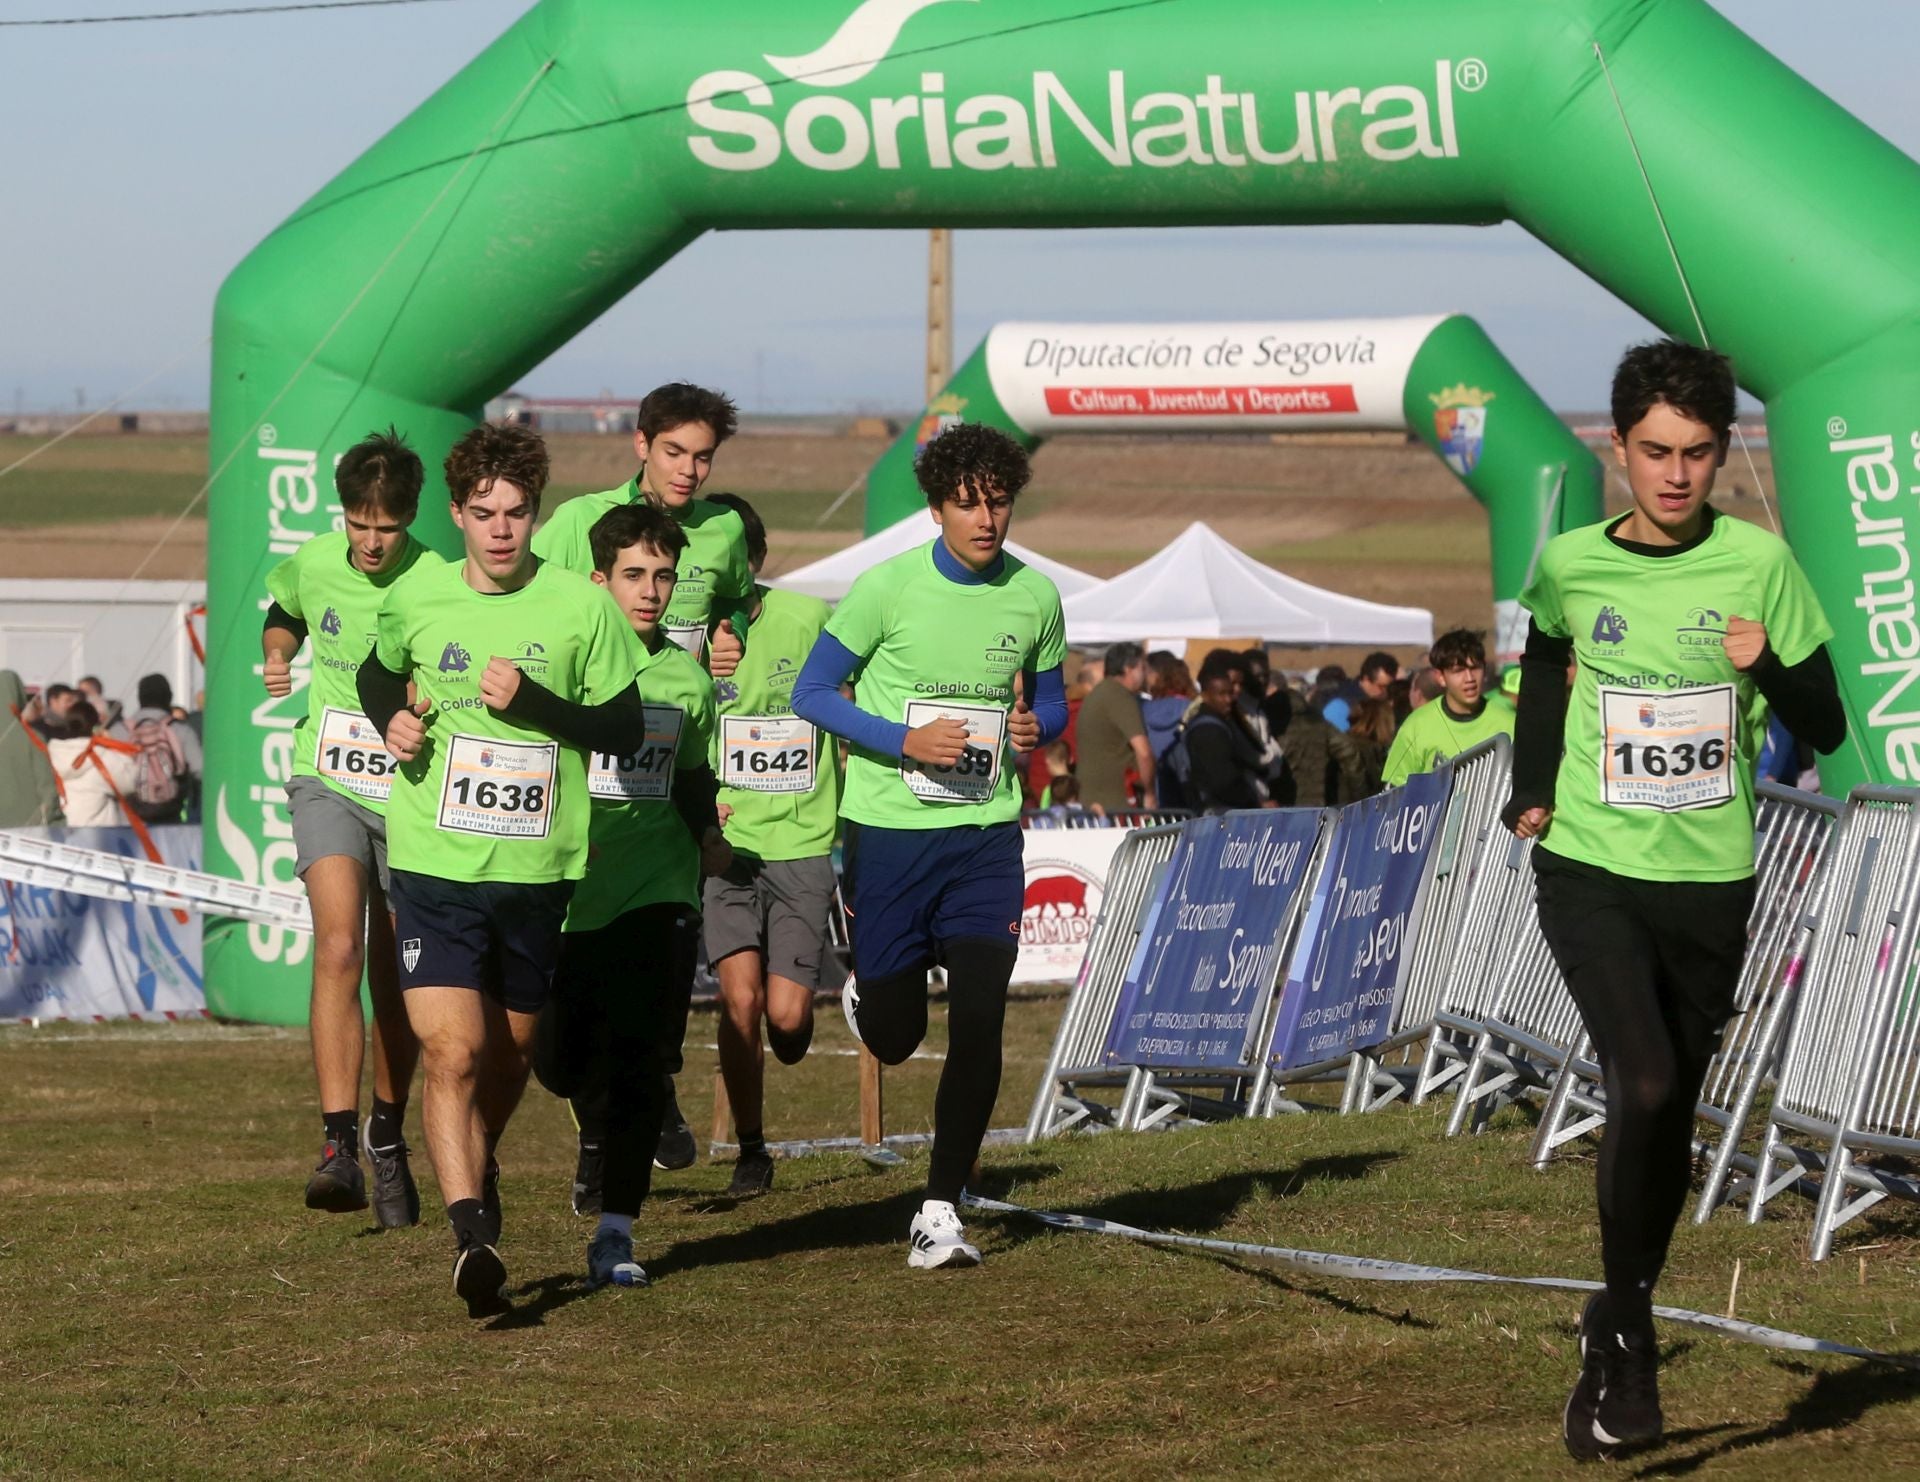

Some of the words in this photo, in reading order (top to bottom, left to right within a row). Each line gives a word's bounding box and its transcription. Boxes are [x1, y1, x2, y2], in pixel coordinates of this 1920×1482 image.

[1023, 338, 1191, 375] Diputación
[1203, 337, 1243, 367] de
[1253, 334, 1376, 375] Segovia
[1068, 387, 1143, 413] Cultura,
[1148, 387, 1226, 412] Juventud
[1232, 394, 1245, 413] y
[1250, 386, 1331, 411] Deportes
[914, 681, 970, 695] Colegio
[440, 697, 483, 711] Coleg
[730, 749, 809, 773] 1642
[1614, 738, 1725, 777] 1636
[1634, 782, 1663, 792] CROSS
[1664, 777, 1707, 793] NACIONAL
[1710, 776, 1720, 784] DE
[453, 777, 544, 812] 1638
[1619, 791, 1688, 804] CANTIMPALOS
[1695, 787, 1720, 799] 2025
[451, 818, 511, 832] CANTIMPALOS
[516, 825, 536, 833] 2025
[466, 810, 490, 821] CROSS
[491, 815, 528, 824] NACIONAL
